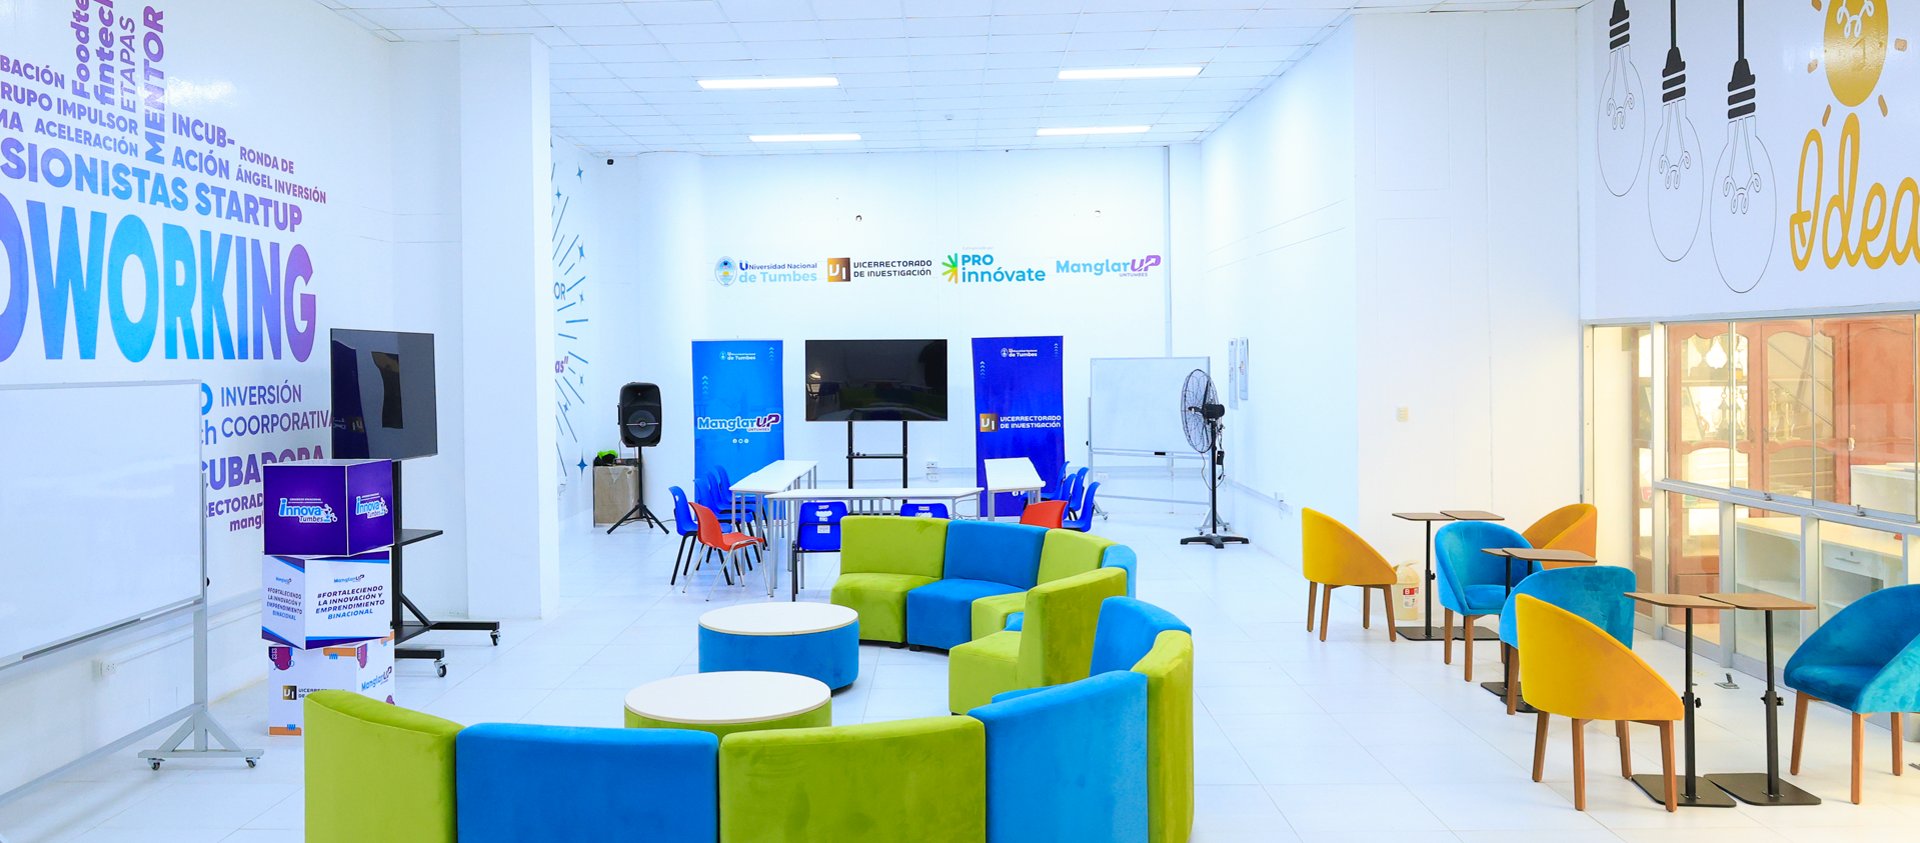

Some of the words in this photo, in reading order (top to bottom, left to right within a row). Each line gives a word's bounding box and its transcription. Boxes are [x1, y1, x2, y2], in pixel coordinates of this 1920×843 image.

[119, 16, 136, 113] ETAPAS
[143, 5, 165, 165] MENTOR
[57, 98, 138, 136] IMPULSOR
[34, 118, 138, 157] ACELERACIÓN
[172, 146, 230, 180] ACIÓN
[239, 147, 280, 171] RONDA
[281, 158, 294, 174] DE
[1, 137, 188, 211] SIONISTAS
[195, 186, 303, 233] STARTUP
[235, 165, 273, 190] ÁNGEL
[274, 180, 326, 204] INVERSIÓN
[961, 254, 994, 266] PRO
[739, 272, 757, 282] de
[762, 270, 817, 282] Tumbes
[962, 267, 1046, 282] innóvate
[221, 379, 302, 407] INVERSIÓN
[317, 585, 383, 598] #FORTALECIENDO
[329, 593, 378, 605] INNOVACIÓN
[315, 600, 385, 614] EMPRENDIMIENTO
[327, 608, 373, 620] BINACIONAL
